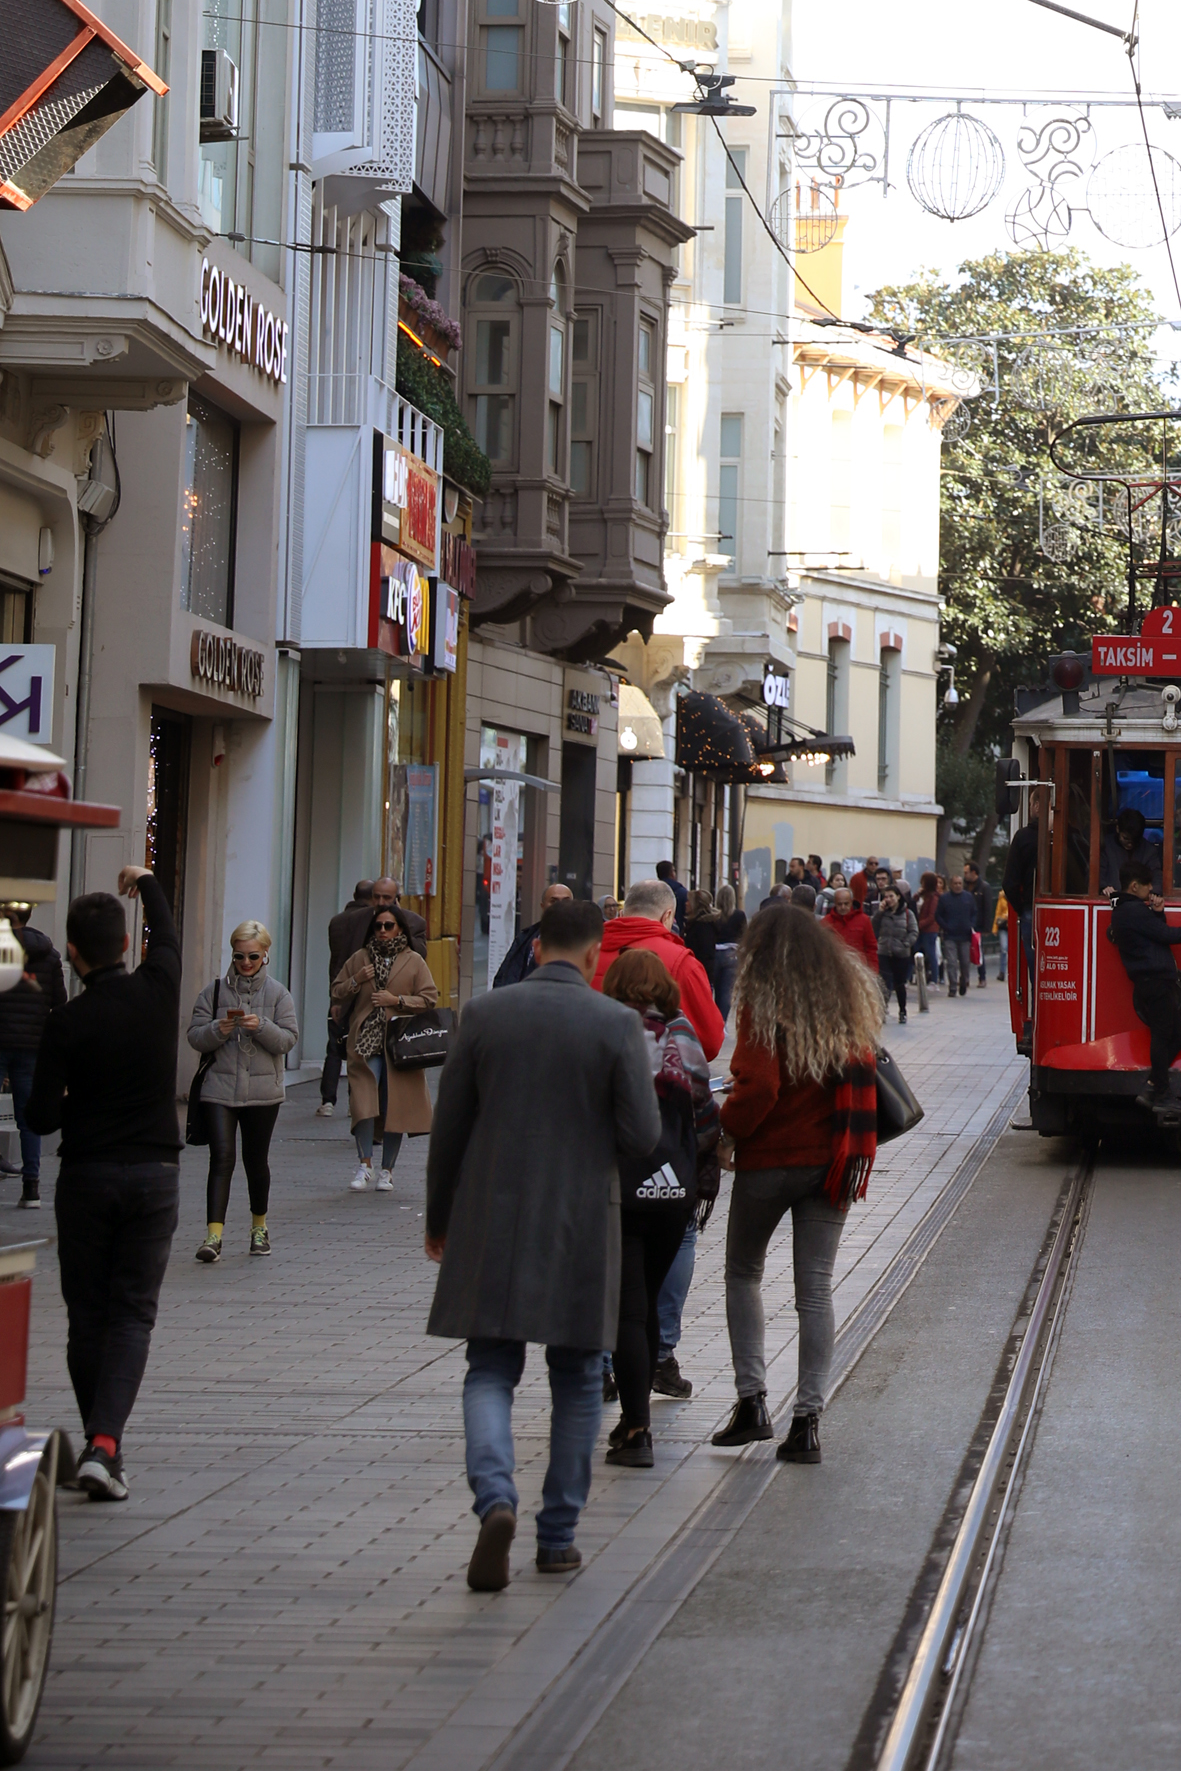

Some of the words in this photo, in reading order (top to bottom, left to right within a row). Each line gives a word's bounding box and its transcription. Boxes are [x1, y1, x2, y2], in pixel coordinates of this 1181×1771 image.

[200, 256, 253, 363] GOLDEN
[255, 302, 288, 384] ROSE
[387, 575, 405, 626] KFC
[1161, 609, 1174, 634] 2
[198, 631, 238, 690] GOLDEN
[241, 648, 264, 697] ROSE
[1098, 642, 1153, 667] TAKSİM
[1044, 926, 1060, 947] 223
[1057, 963, 1068, 971] 153
[1057, 981, 1076, 989] YASAK
[636, 1185, 686, 1199] adidas
